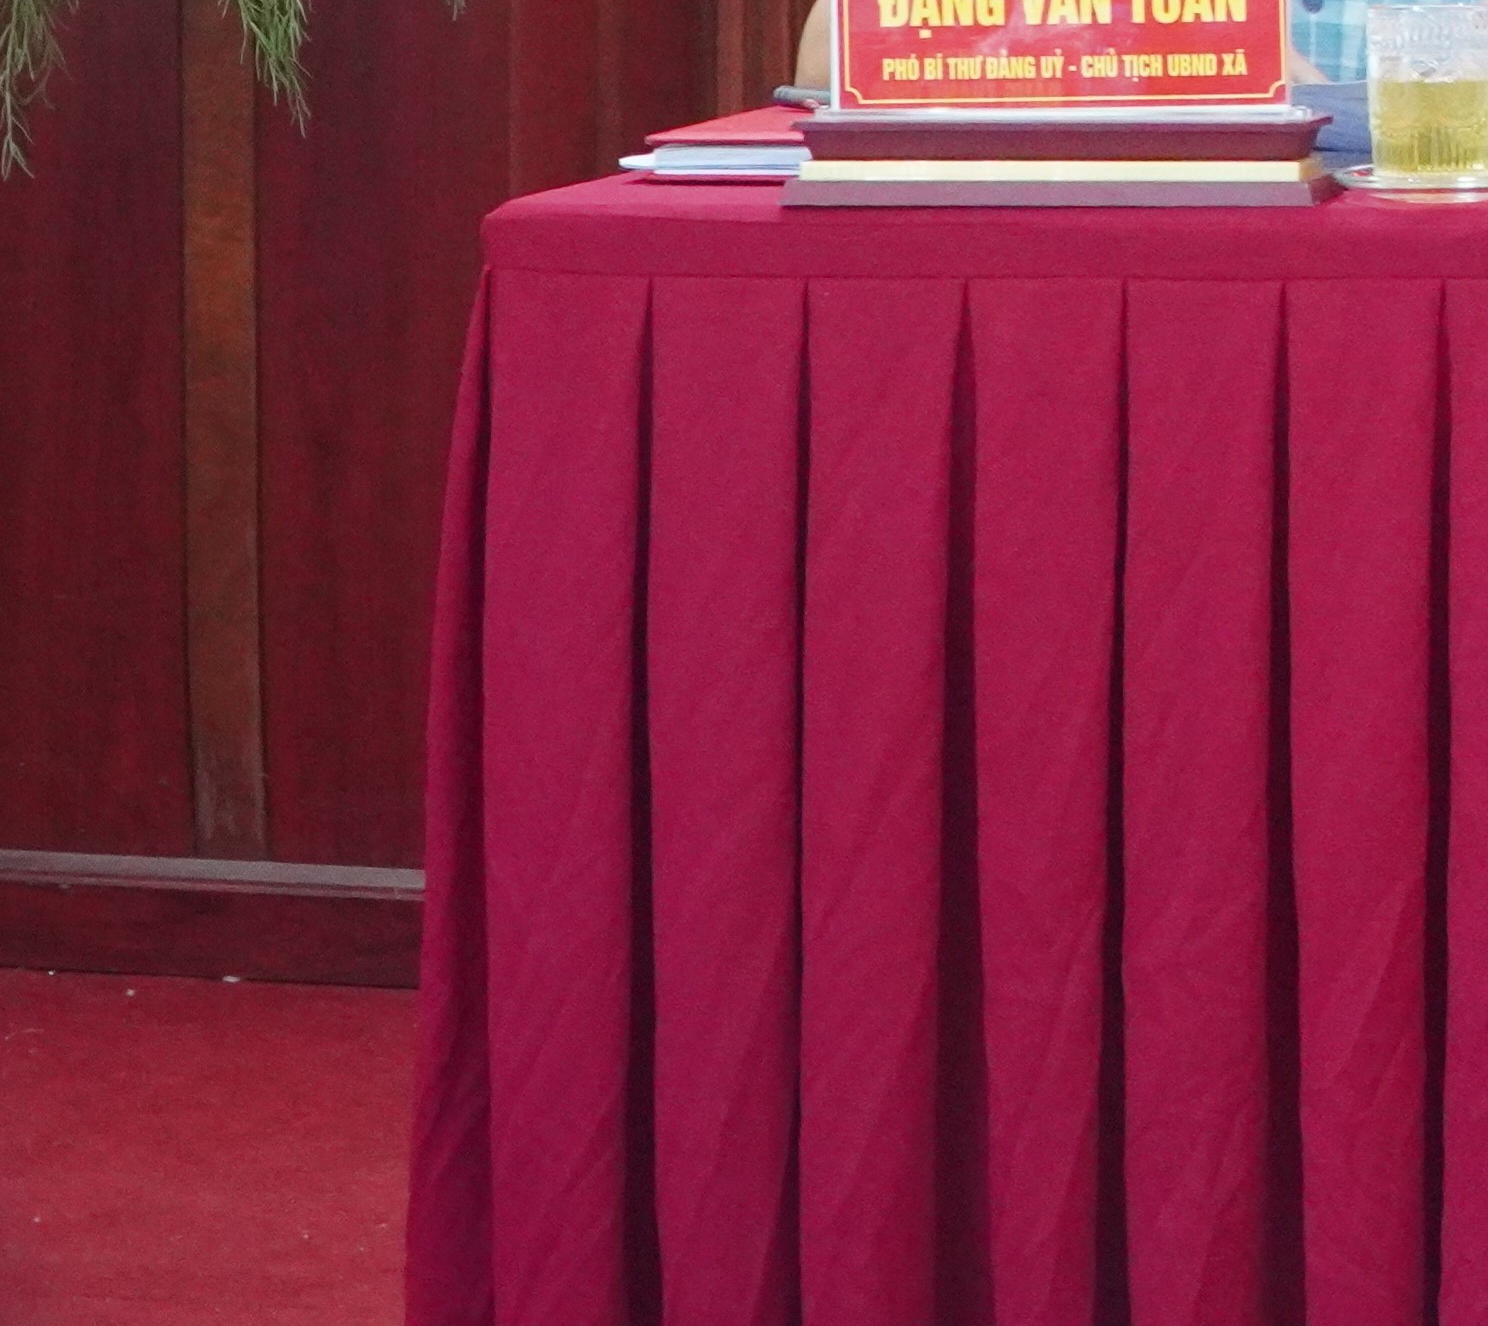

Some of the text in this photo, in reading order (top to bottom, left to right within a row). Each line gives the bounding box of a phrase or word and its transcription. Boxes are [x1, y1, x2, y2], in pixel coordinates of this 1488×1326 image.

[882, 53, 920, 81] PHÓ
[923, 53, 944, 80] BÍ
[946, 54, 984, 80] THƯ
[984, 49, 1037, 80] ĐẢNG
[1081, 48, 1119, 78] CHỦ
[1121, 54, 1164, 83] TỊCH
[1166, 53, 1218, 77] UBND
[1221, 49, 1248, 76] XÃ
